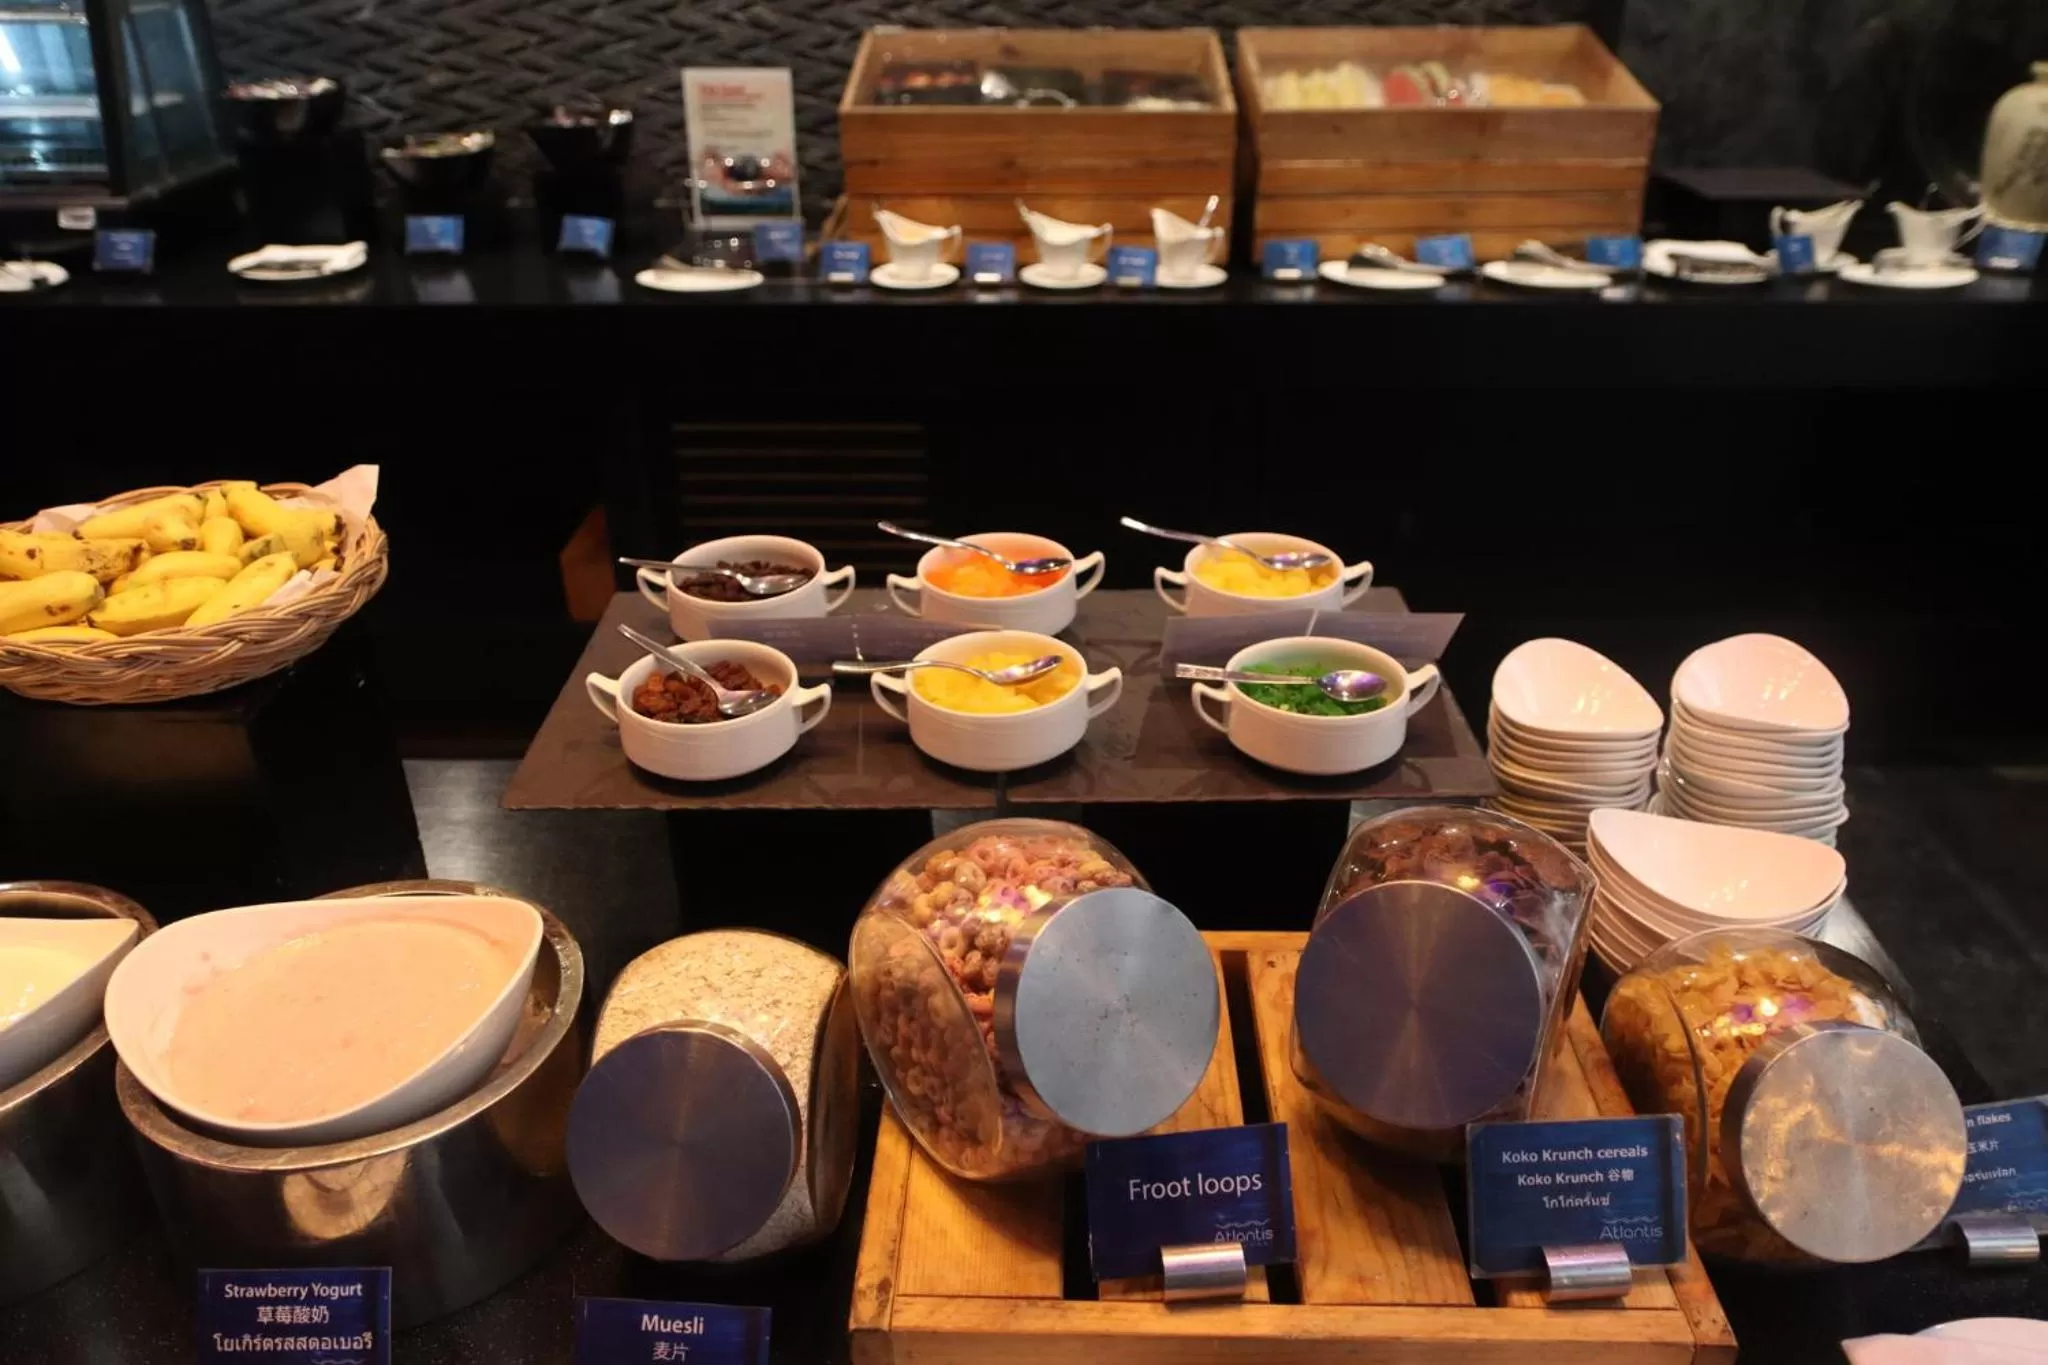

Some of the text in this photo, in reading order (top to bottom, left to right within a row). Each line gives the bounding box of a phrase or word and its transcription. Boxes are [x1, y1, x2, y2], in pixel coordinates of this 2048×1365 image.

[1977, 1113, 2011, 1126] flakes
[1501, 1144, 1649, 1164] Koko Krunch cereals
[1129, 1172, 1262, 1200] Froot loops
[1517, 1173, 1552, 1187] Koko
[1555, 1170, 1604, 1185] Krunch
[1214, 1228, 1274, 1243] Atlantis
[1599, 1224, 1663, 1240] Atlantis
[224, 1283, 363, 1300] Strawberry Yogurt
[256, 1305, 330, 1325] 草莓酸奶
[641, 1314, 705, 1336] Muesli
[652, 1341, 689, 1362] 麦片
